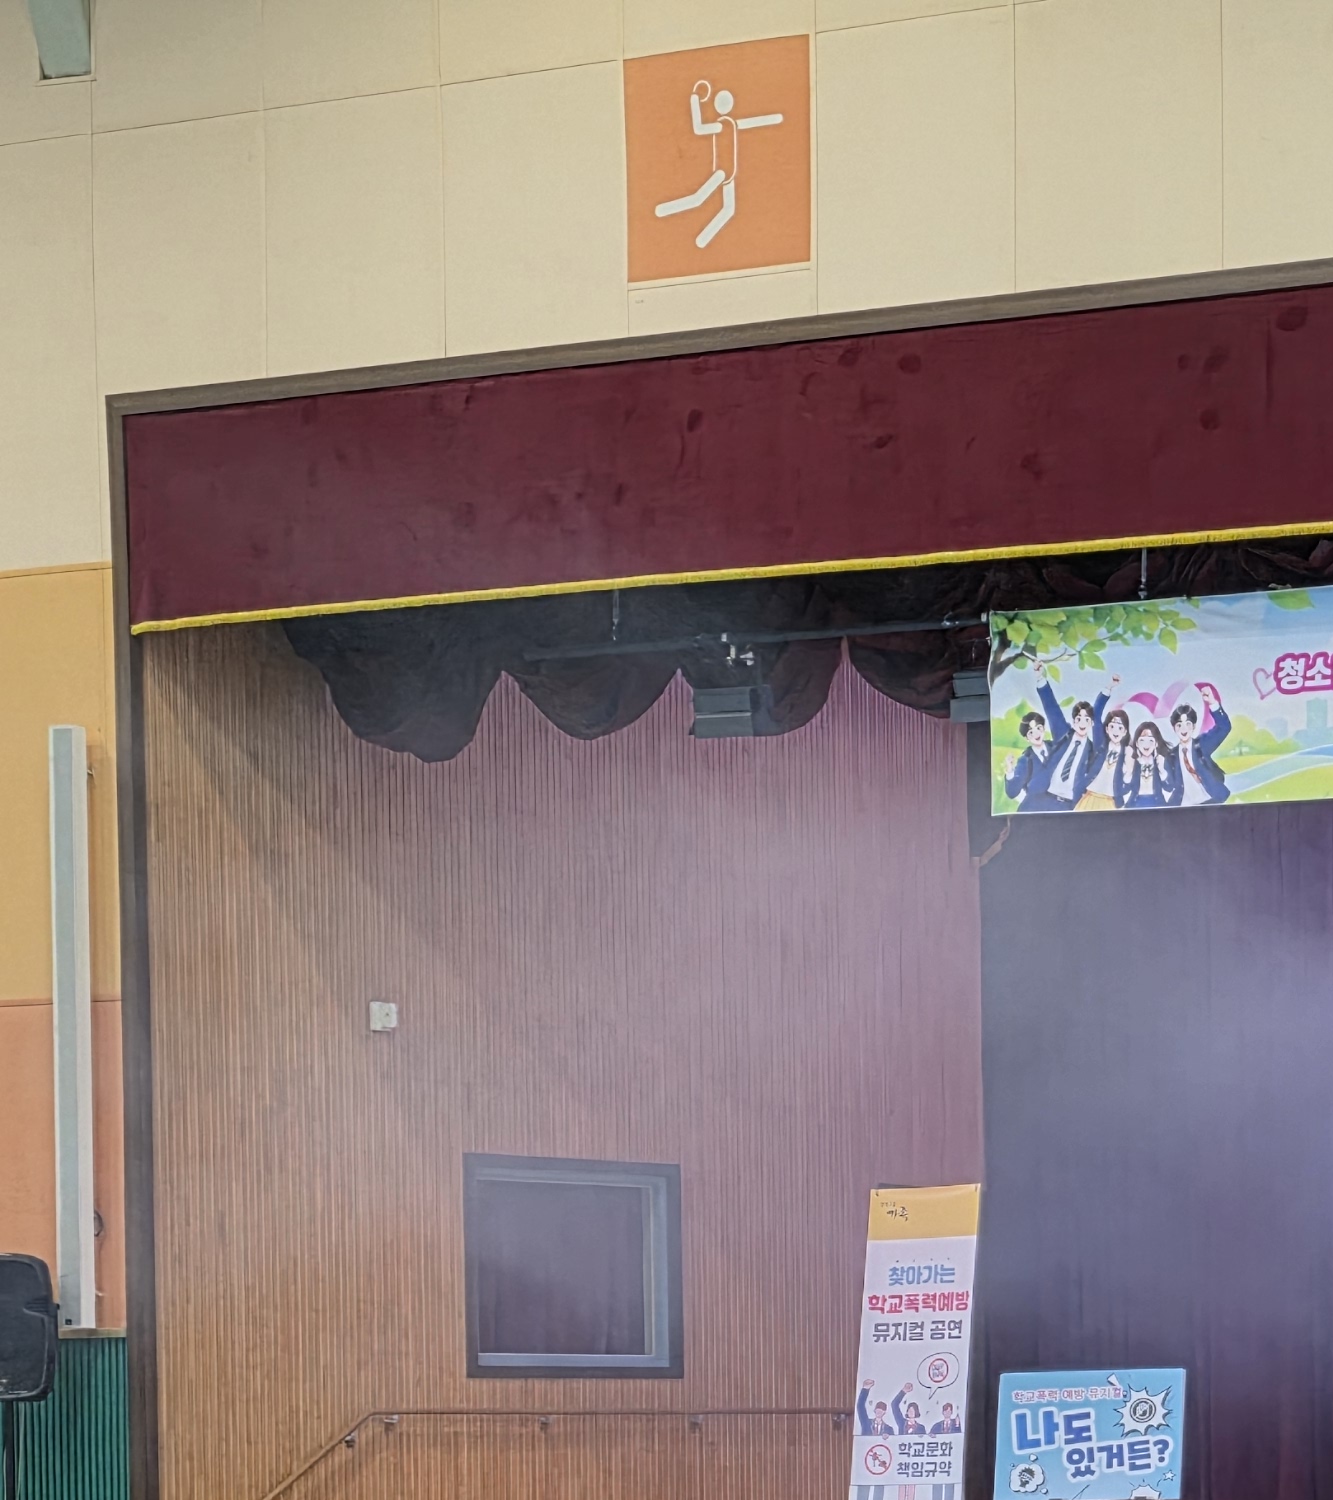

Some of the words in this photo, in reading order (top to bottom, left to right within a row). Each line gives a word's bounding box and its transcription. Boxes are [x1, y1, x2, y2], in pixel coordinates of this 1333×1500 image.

[888, 1264, 956, 1287] 찾아가는
[868, 1290, 970, 1315] 학교폭력예방
[873, 1321, 925, 1343] 뮤지컬
[930, 1319, 963, 1341] 공연
[1013, 1390, 1058, 1403] 학교폭력
[1062, 1388, 1085, 1400] 예방
[1089, 1387, 1122, 1399] 뮤지컬
[1015, 1409, 1093, 1450] 나도
[898, 1441, 953, 1458] 학교문화
[1066, 1438, 1170, 1479] 있거든?
[896, 1461, 952, 1478] 책임규약
